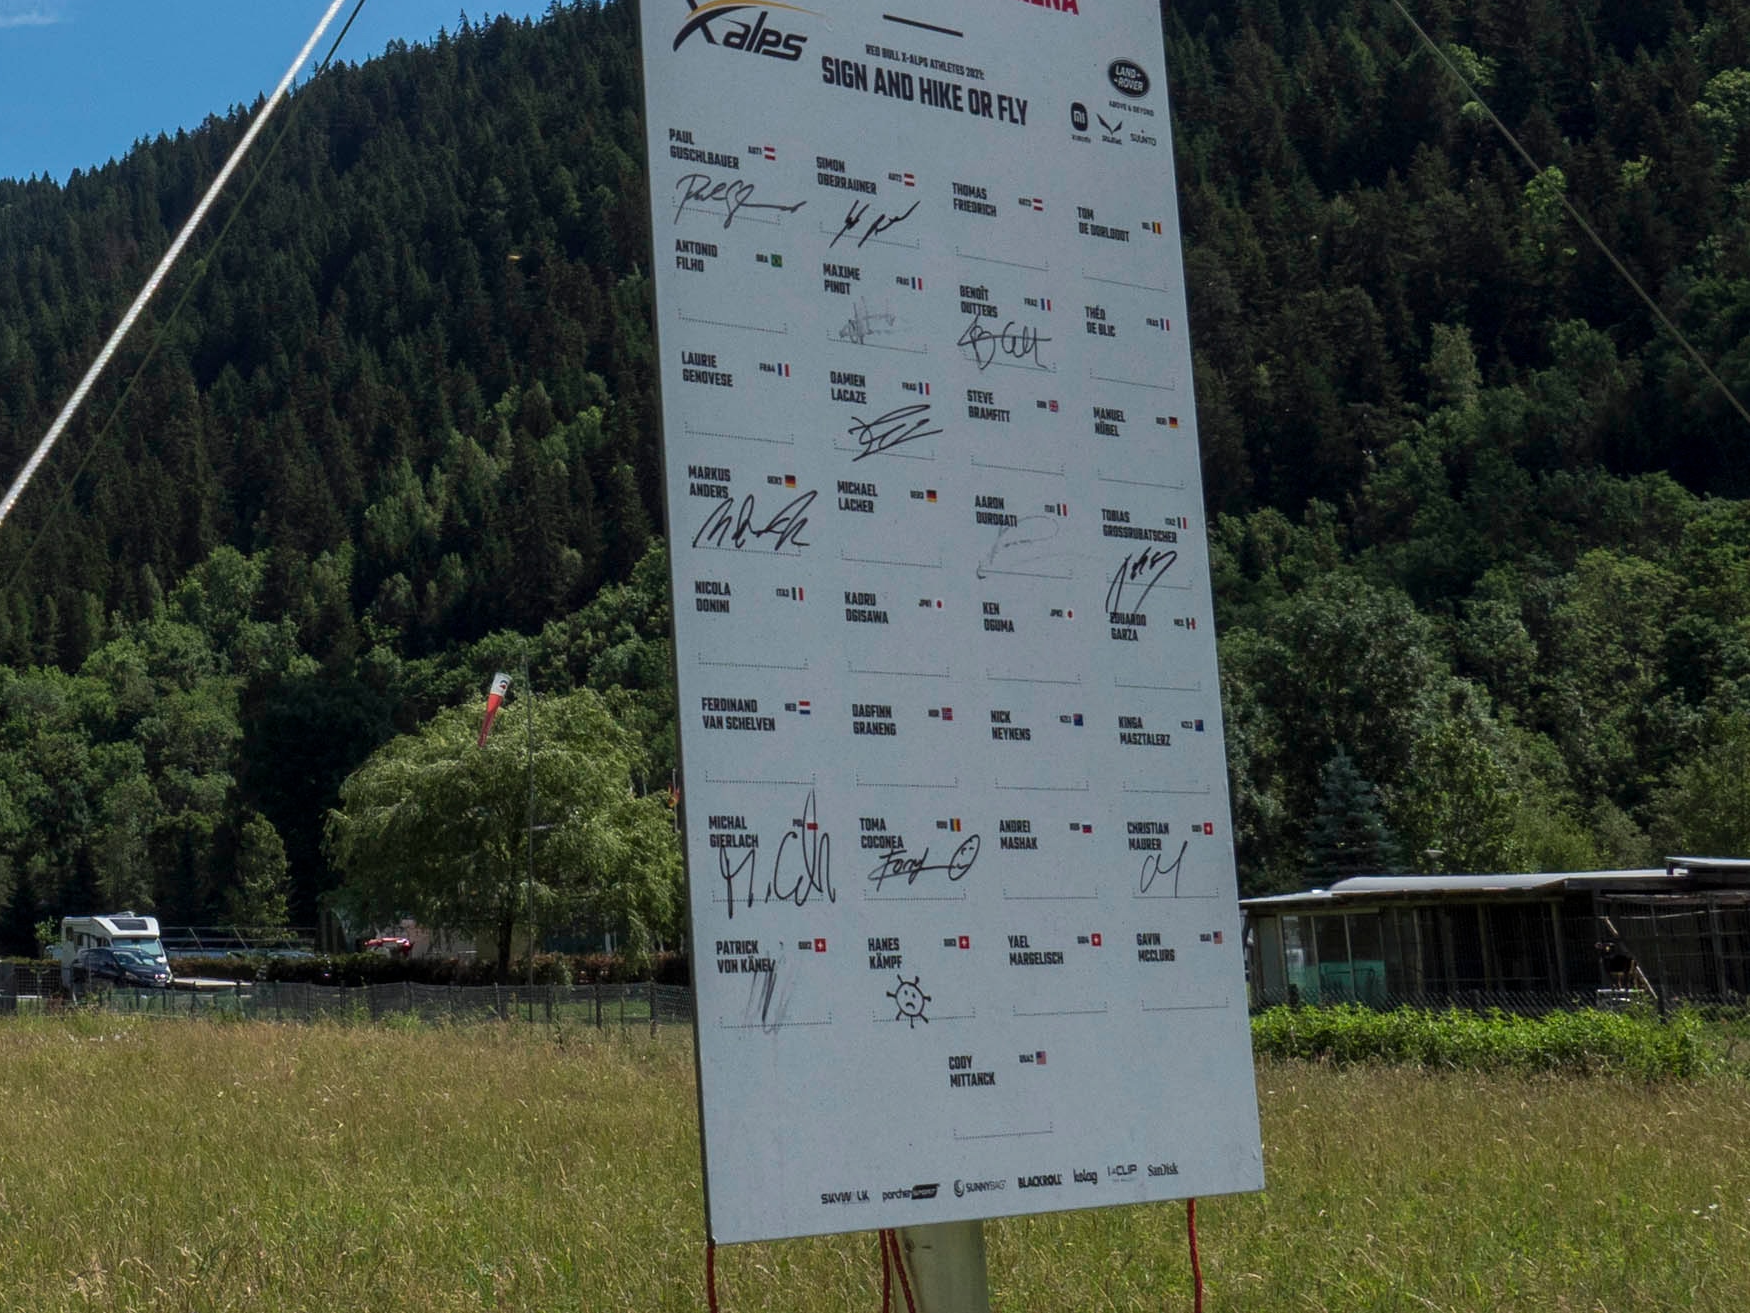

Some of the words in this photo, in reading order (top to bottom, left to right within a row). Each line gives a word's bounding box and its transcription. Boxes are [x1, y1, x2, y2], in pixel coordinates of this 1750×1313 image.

[864, 43, 880, 57] RED
[881, 46, 901, 62] BULL
[900, 51, 928, 69] X-ALPS
[928, 57, 965, 77] ATHLETES
[1114, 63, 1136, 80] LAND
[821, 54, 869, 93] SIGN
[871, 65, 915, 103] AND
[917, 75, 964, 113] HIKE
[966, 86, 994, 120] OR
[996, 93, 1030, 128] FLY
[1116, 76, 1144, 92] ROVER
[668, 127, 694, 145] PAUL
[669, 144, 739, 170] GUSCHLBAUER
[815, 155, 845, 174] SIMON
[816, 171, 877, 195] OBERRAUNER
[951, 181, 988, 200] THOMAS
[952, 197, 997, 217] FRIEDRICH
[1076, 205, 1094, 221] TOM
[1077, 220, 1090, 236] DE
[674, 237, 718, 259] ANTONIO
[675, 255, 705, 273] FILHO
[822, 262, 861, 281] MAXIME
[823, 278, 851, 295] PINOT
[960, 299, 998, 318] OUTTERS
[1085, 320, 1097, 335] DE
[1097, 322, 1116, 338] BLIC
[680, 350, 717, 369] LAURIE
[681, 367, 733, 388] GENOVESE
[829, 370, 866, 388] DAMIEN
[830, 387, 867, 405] LACAZE
[966, 388, 994, 405] STEVE
[967, 404, 1011, 423] BRAMFITT
[1092, 405, 1126, 423] MANUEL
[687, 464, 731, 482] MARKUS
[688, 481, 729, 500] ANDERS
[836, 479, 878, 498] MICHAEL
[837, 496, 875, 514] LACHER
[973, 494, 1005, 510] AARON
[1101, 507, 1131, 523] TOBIAS
[1102, 523, 1178, 544] GROSSRUBATSCHER
[694, 579, 731, 596] NICOLA
[695, 597, 730, 614] DONINI
[844, 590, 877, 607] KAORU
[844, 607, 889, 624] OGISAWA
[981, 601, 1000, 616] KEN
[983, 617, 1015, 633] OGUMA
[1110, 626, 1139, 641] GARZA
[700, 696, 758, 713] FERDINAND
[851, 703, 892, 719] DAGFINN
[702, 714, 724, 730] VAN
[724, 715, 776, 732] SCHELVEN
[990, 709, 1011, 724] NICK
[1117, 715, 1143, 729] KINGA
[852, 720, 897, 736] GRANENG
[991, 726, 1032, 741] NEYNENS
[1118, 731, 1171, 747] MASZTALERZ
[707, 815, 748, 830] MICHAL
[858, 817, 887, 832] TOMA
[998, 819, 1031, 833] ANDREI
[1126, 821, 1170, 835] CHRISTIAN
[708, 833, 759, 848] GIERLACH
[860, 834, 904, 849] COCONEA
[999, 836, 1039, 850] MASHAK
[1127, 837, 1163, 851] MAURER
[715, 939, 759, 955] PATRICK
[867, 936, 900, 952] HANES
[1007, 934, 1031, 949] YAEL
[1135, 932, 1162, 946] GAVIN
[868, 951, 903, 970] KÄMPF
[1008, 950, 1064, 966] MARGELISCH
[1137, 948, 1176, 963] MCCLURG
[716, 958, 739, 974] VON
[947, 1054, 973, 1070] CODY
[949, 1071, 996, 1088] MITTANCK
[1146, 1161, 1179, 1177] SanDisk
[1017, 1173, 1062, 1189] BLACKROLL
[820, 1188, 870, 1206] SKYWLK
